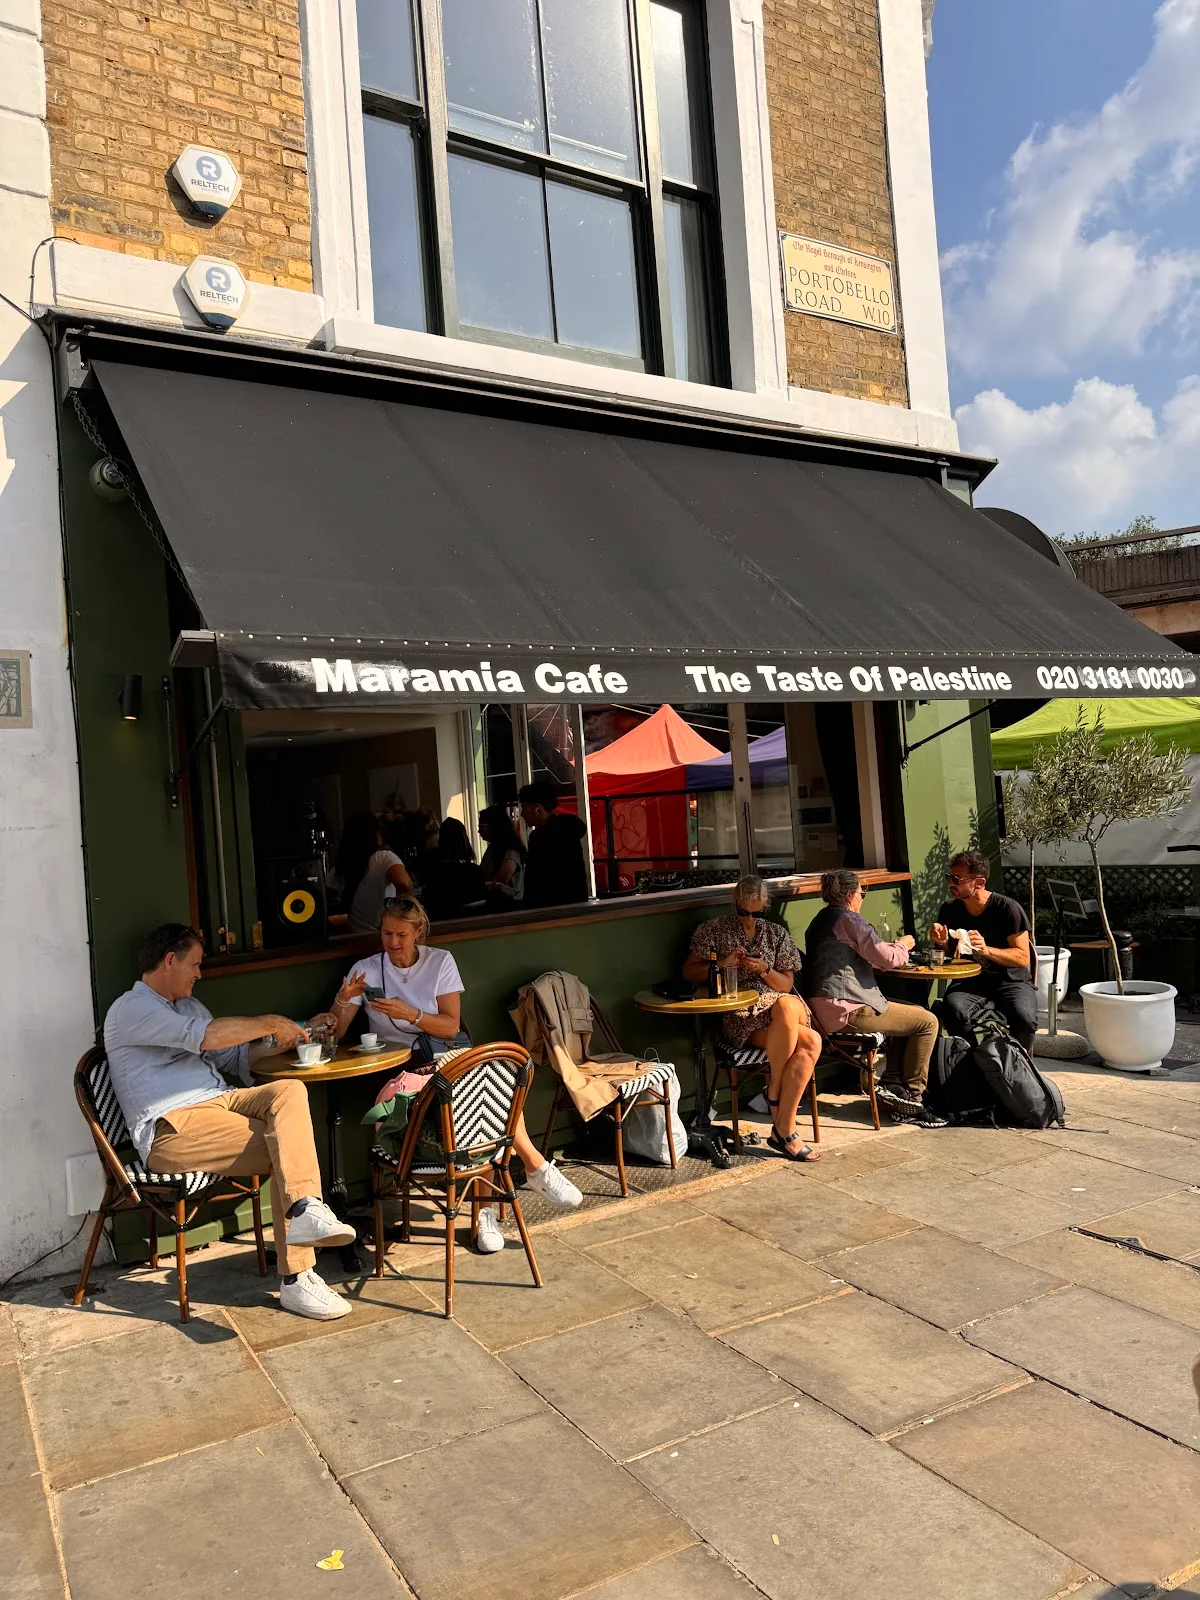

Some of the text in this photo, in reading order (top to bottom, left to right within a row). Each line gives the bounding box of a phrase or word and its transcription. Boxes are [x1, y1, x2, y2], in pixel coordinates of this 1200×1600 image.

[190, 178, 230, 193] RELTECH
[792, 241, 804, 251] The
[823, 249, 846, 264] Borough
[847, 256, 853, 265] of
[835, 265, 857, 279] Chelsea
[200, 289, 239, 304] RELTECH
[789, 266, 890, 306] PORTOBELLO
[862, 304, 890, 326] W.10
[311, 657, 1185, 694] Maramia Cafe The Taste Of Palestine 020 3181 0030
